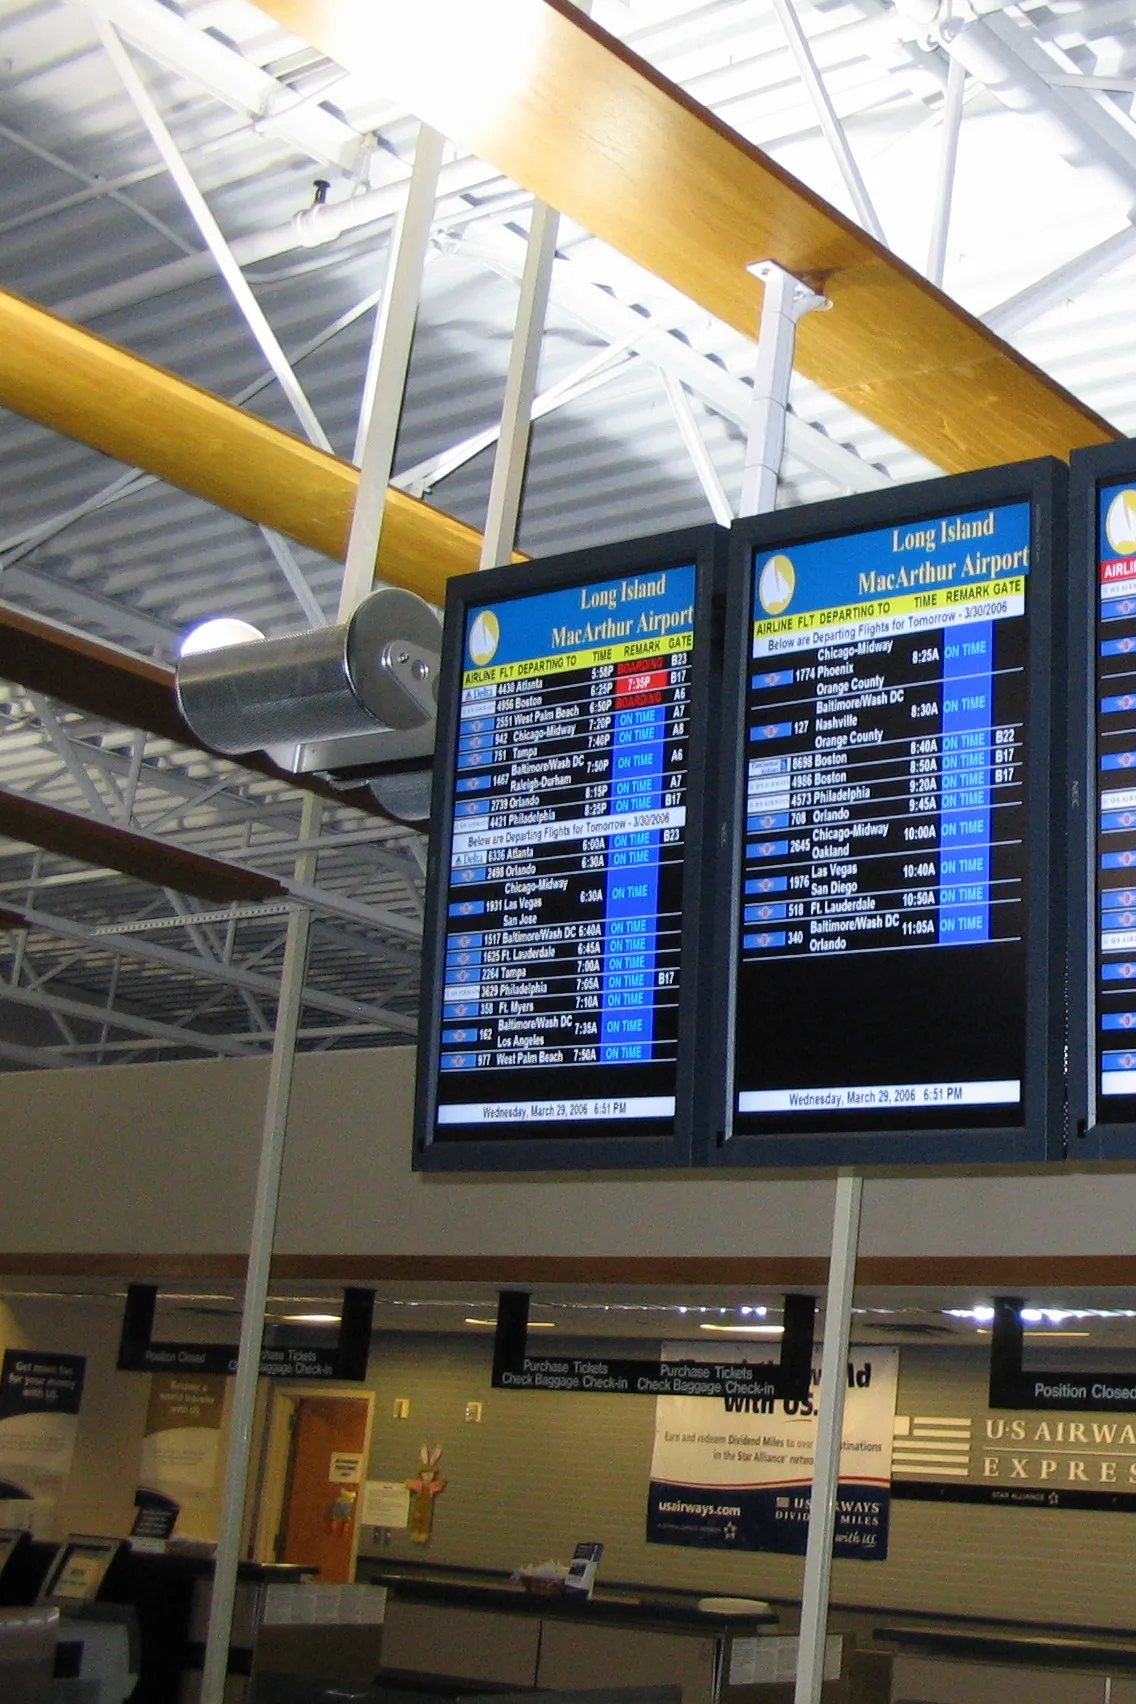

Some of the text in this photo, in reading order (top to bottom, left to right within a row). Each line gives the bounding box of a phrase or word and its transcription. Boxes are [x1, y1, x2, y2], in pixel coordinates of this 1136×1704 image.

[892, 512, 995, 553] Long Island
[858, 550, 1030, 594] MacArthur Airport
[580, 574, 666, 610] Long Island
[756, 580, 1021, 636] AIRLINE FLT DEPARTING TO TIME REMARK GATE
[551, 604, 694, 649] MacArthur Airport
[768, 601, 1007, 651] Below are Departing Flights for Tomorrow 3/30/2006
[465, 635, 692, 684] AIRLINE FLT DEPARTING TO TIME REMARK GATE
[483, 1102, 626, 1119] Wednesday, March 29, 2006 6:51 PM
[523, 1360, 608, 1374] Purchase Tickets
[660, 1364, 753, 1379] Purchase Tickets
[502, 1372, 628, 1389] Check Baggage Check-in
[637, 1377, 774, 1394] Check Baggage Check-in
[1034, 1383, 1086, 1399] Position
[682, 1433, 695, 1441] and
[728, 1435, 761, 1446] Dividend
[762, 1437, 784, 1447] Miles
[737, 1451, 785, 1463] Star Alliance
[659, 1502, 741, 1516] usairways.com
[841, 1516, 878, 1525] MILES
